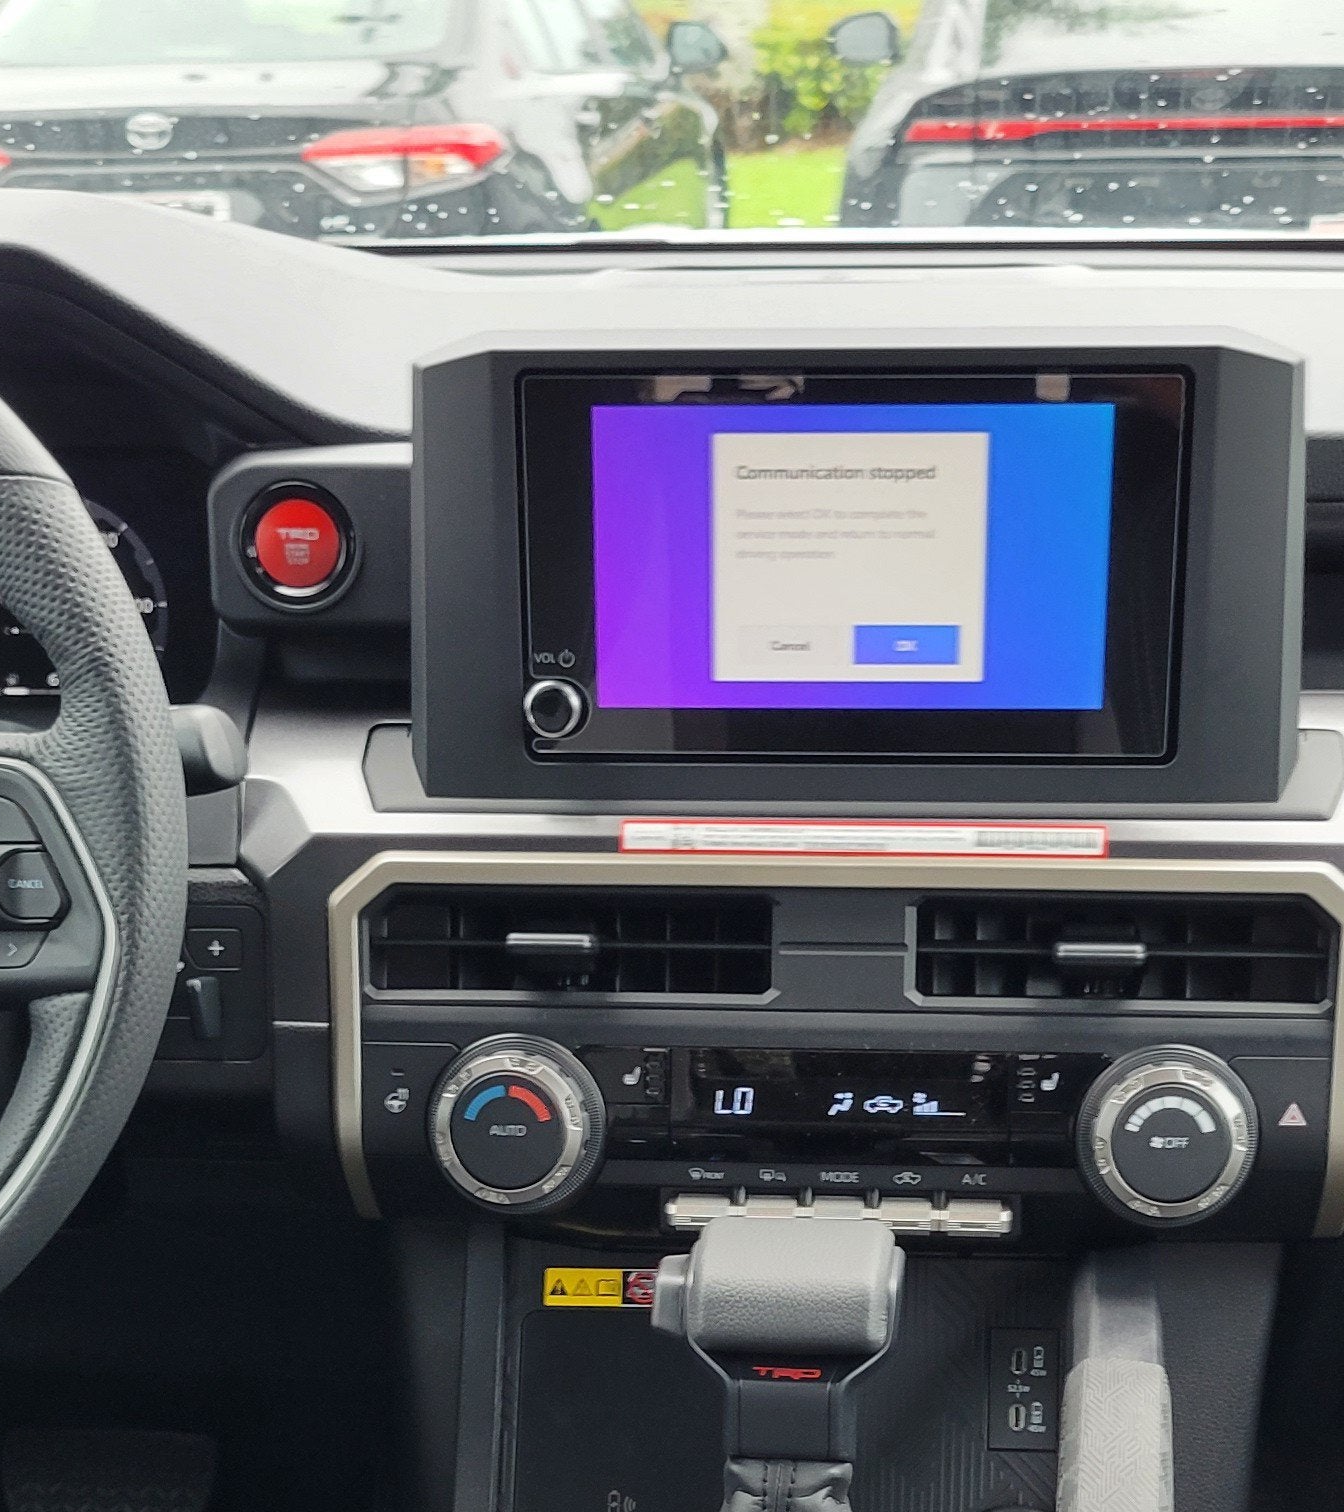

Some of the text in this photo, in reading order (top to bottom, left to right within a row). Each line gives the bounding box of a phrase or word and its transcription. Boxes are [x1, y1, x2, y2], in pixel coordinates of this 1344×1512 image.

[735, 466, 937, 483] Communication stopped
[276, 527, 320, 541] TRD
[533, 652, 556, 664] VOL
[7, 878, 44, 890] CANCEL
[488, 1124, 528, 1137] AUTO
[1164, 1136, 1190, 1149] OFF
[819, 1170, 860, 1183] MODE
[961, 1173, 987, 1185] A/C
[752, 1366, 823, 1380] TRD
